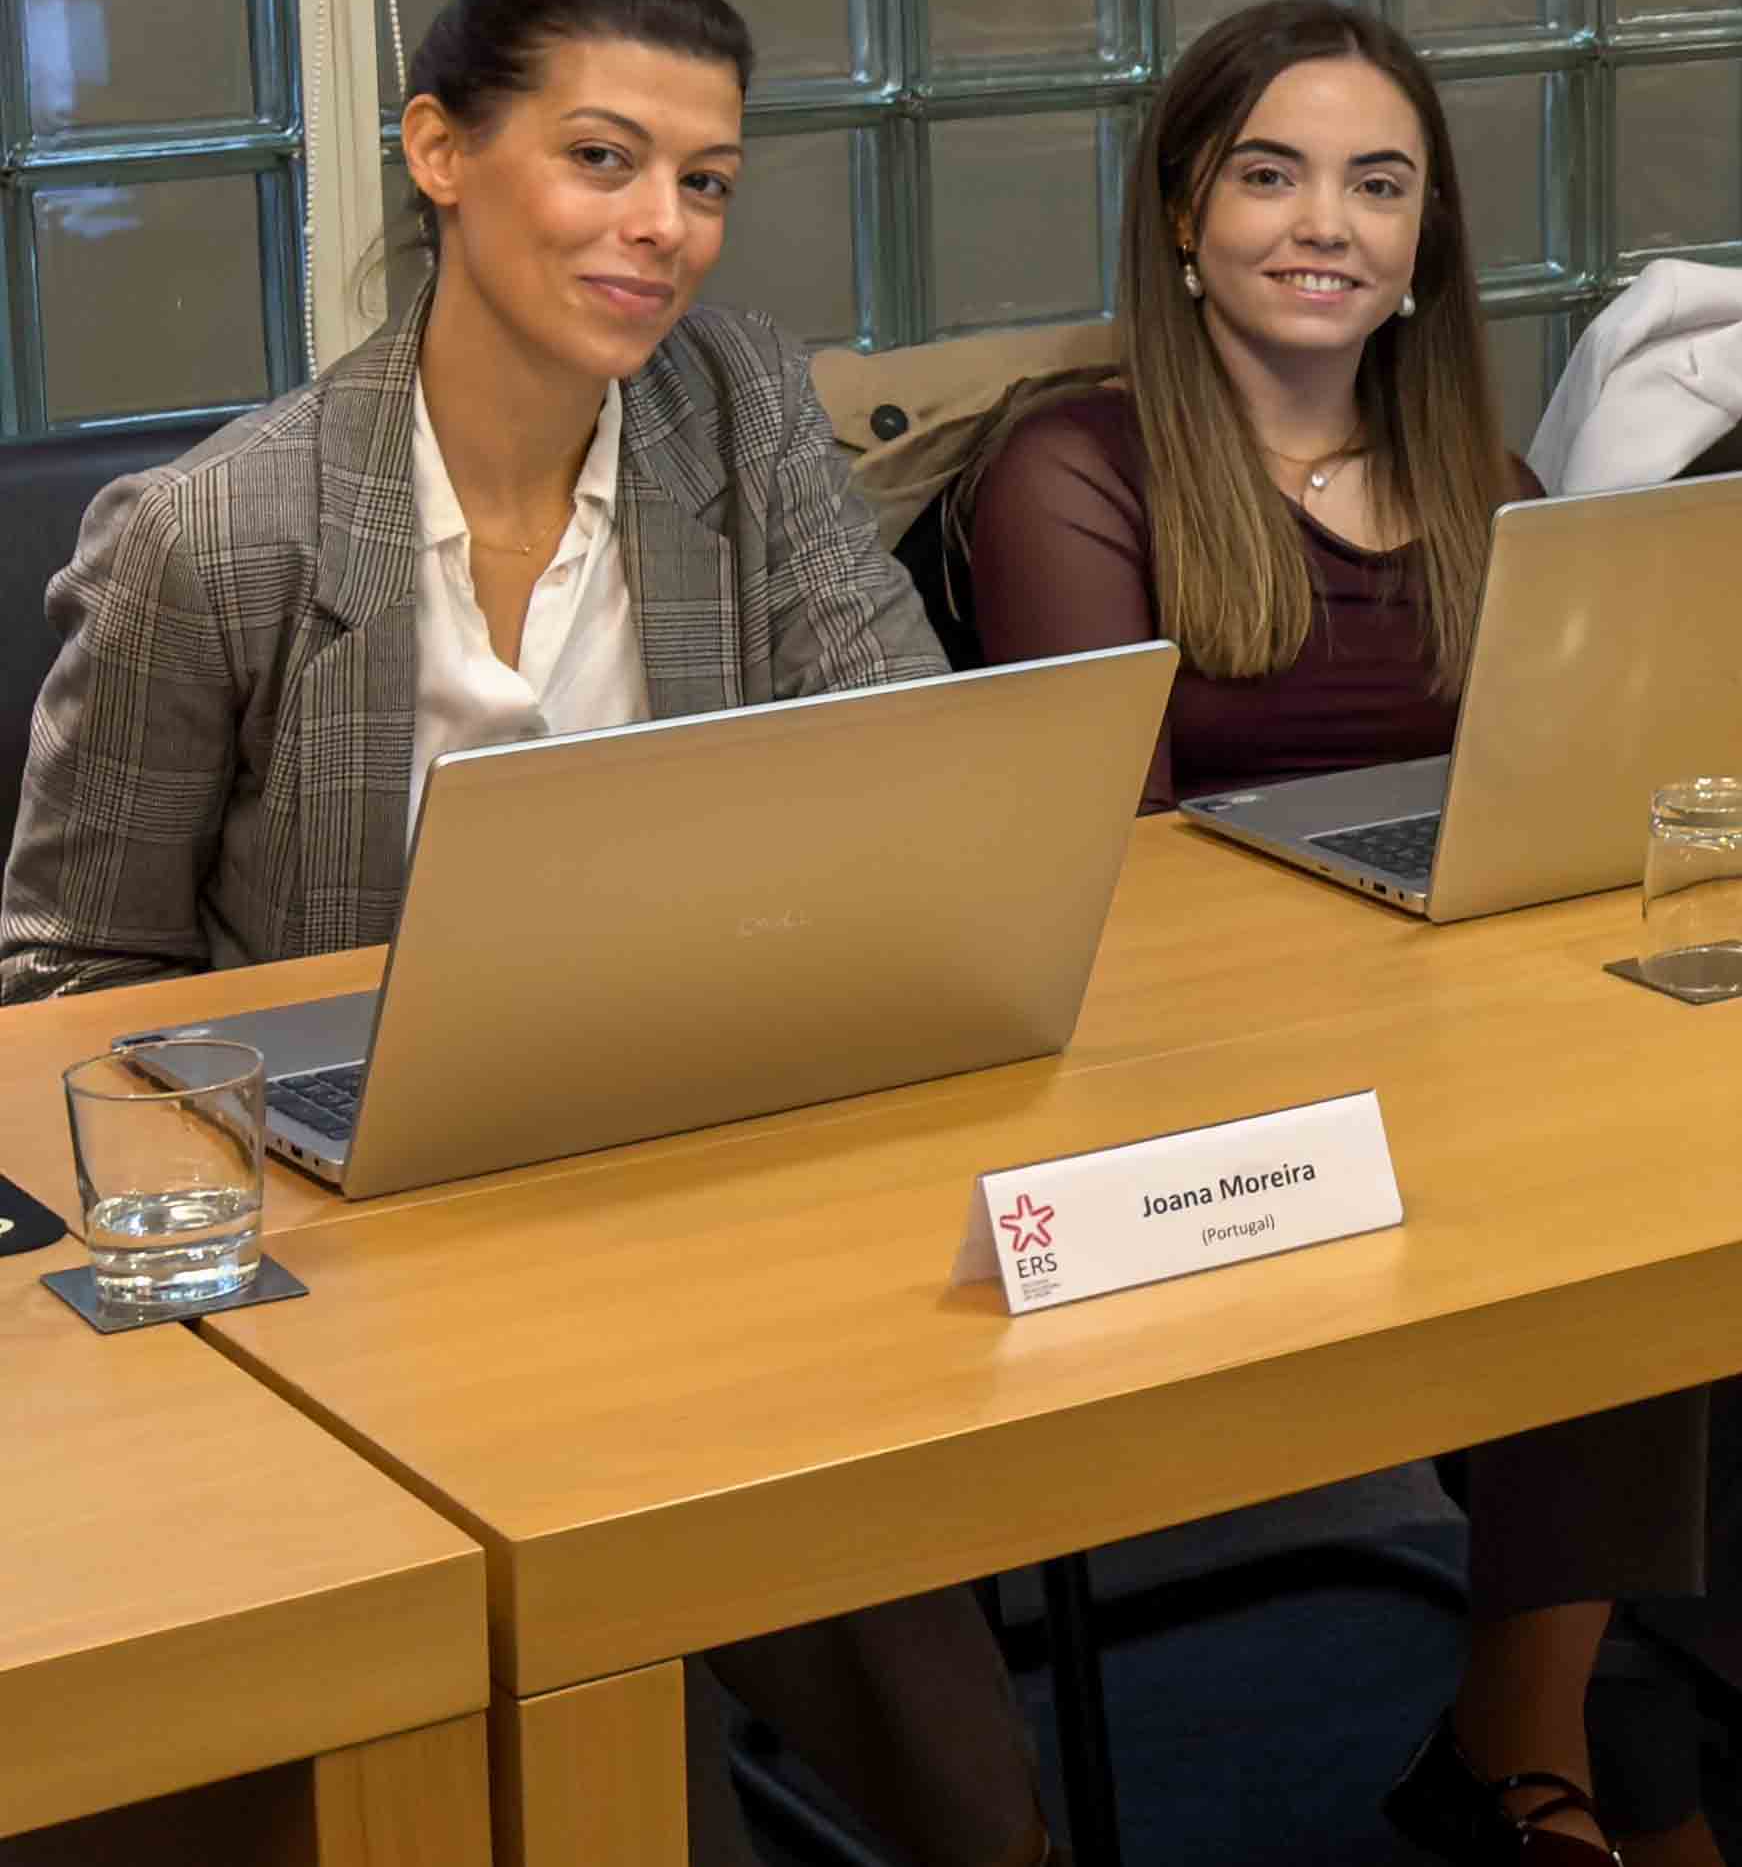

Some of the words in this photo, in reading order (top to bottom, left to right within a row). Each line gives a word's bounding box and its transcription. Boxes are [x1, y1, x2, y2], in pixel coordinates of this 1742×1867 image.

[1143, 1187, 1213, 1218] Joana
[1219, 1163, 1316, 1200] Moreira
[1202, 1214, 1275, 1247] (Portugal)
[1016, 1252, 1058, 1279] ERS
